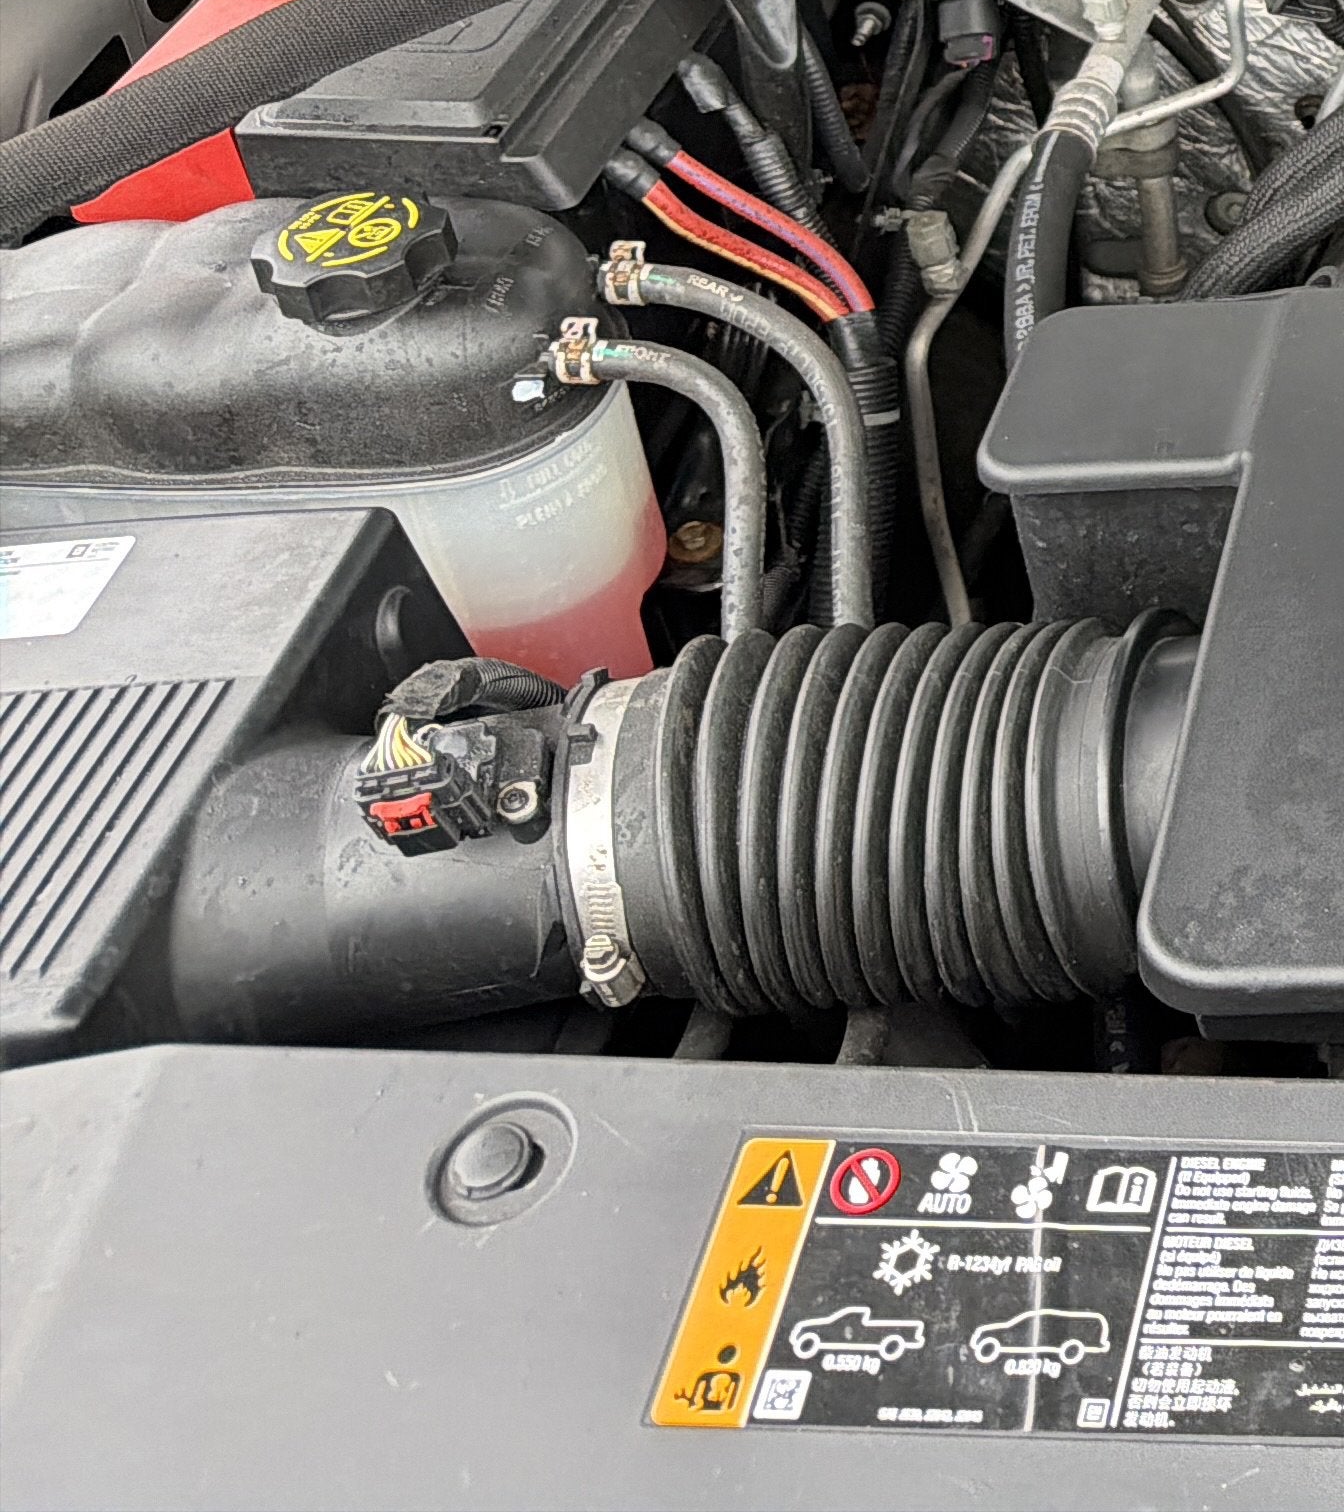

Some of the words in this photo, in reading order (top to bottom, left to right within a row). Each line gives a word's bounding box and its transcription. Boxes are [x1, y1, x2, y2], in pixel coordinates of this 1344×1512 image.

[1181, 1157, 1220, 1170] DIESEL
[918, 1191, 971, 1214] AUTO
[947, 1255, 1012, 1275] R-1234yf
[1015, 1254, 1042, 1274] PAG
[1043, 1257, 1062, 1272] oil
[822, 1354, 862, 1371] 0.550
[862, 1355, 880, 1374] kg
[1043, 1358, 1061, 1378] kg
